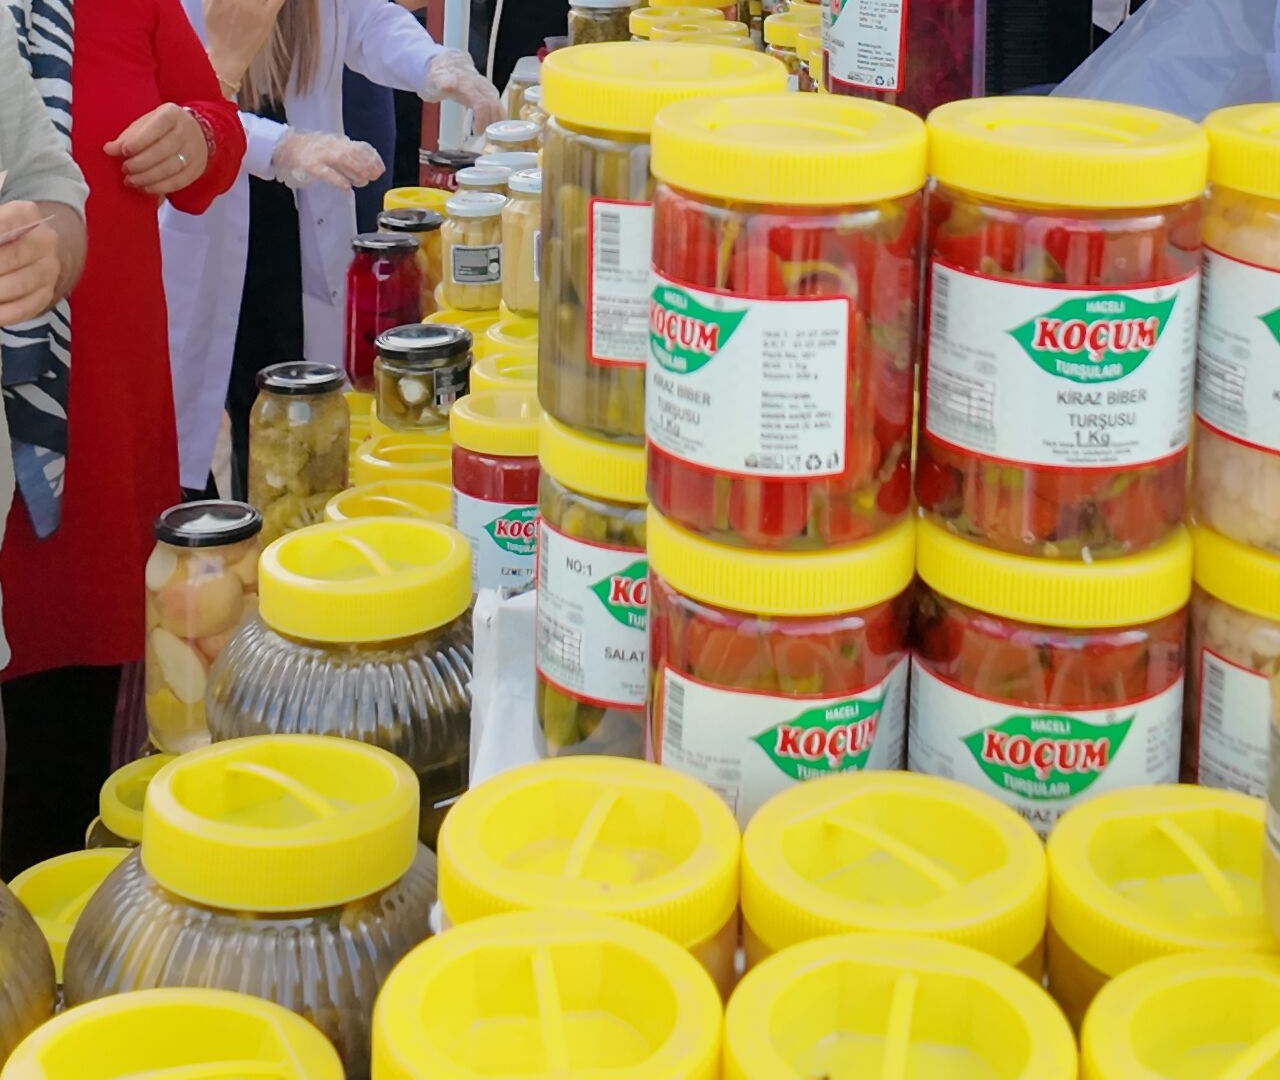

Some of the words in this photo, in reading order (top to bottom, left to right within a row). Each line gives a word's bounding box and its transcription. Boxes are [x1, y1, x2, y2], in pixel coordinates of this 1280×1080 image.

[1034, 318, 1159, 361] KOÇUM
[1055, 358, 1123, 380] TURŞULARI
[1106, 388, 1148, 405] BİBER
[1067, 411, 1136, 432] TURŞUSU
[496, 520, 537, 542] KOÇ
[565, 556, 593, 576] NO:1
[825, 703, 860, 721] HACELİ
[1030, 719, 1071, 734] HACELİ
[981, 729, 1110, 779] KOÇUM
[1002, 771, 1071, 799] TURŞULARI
